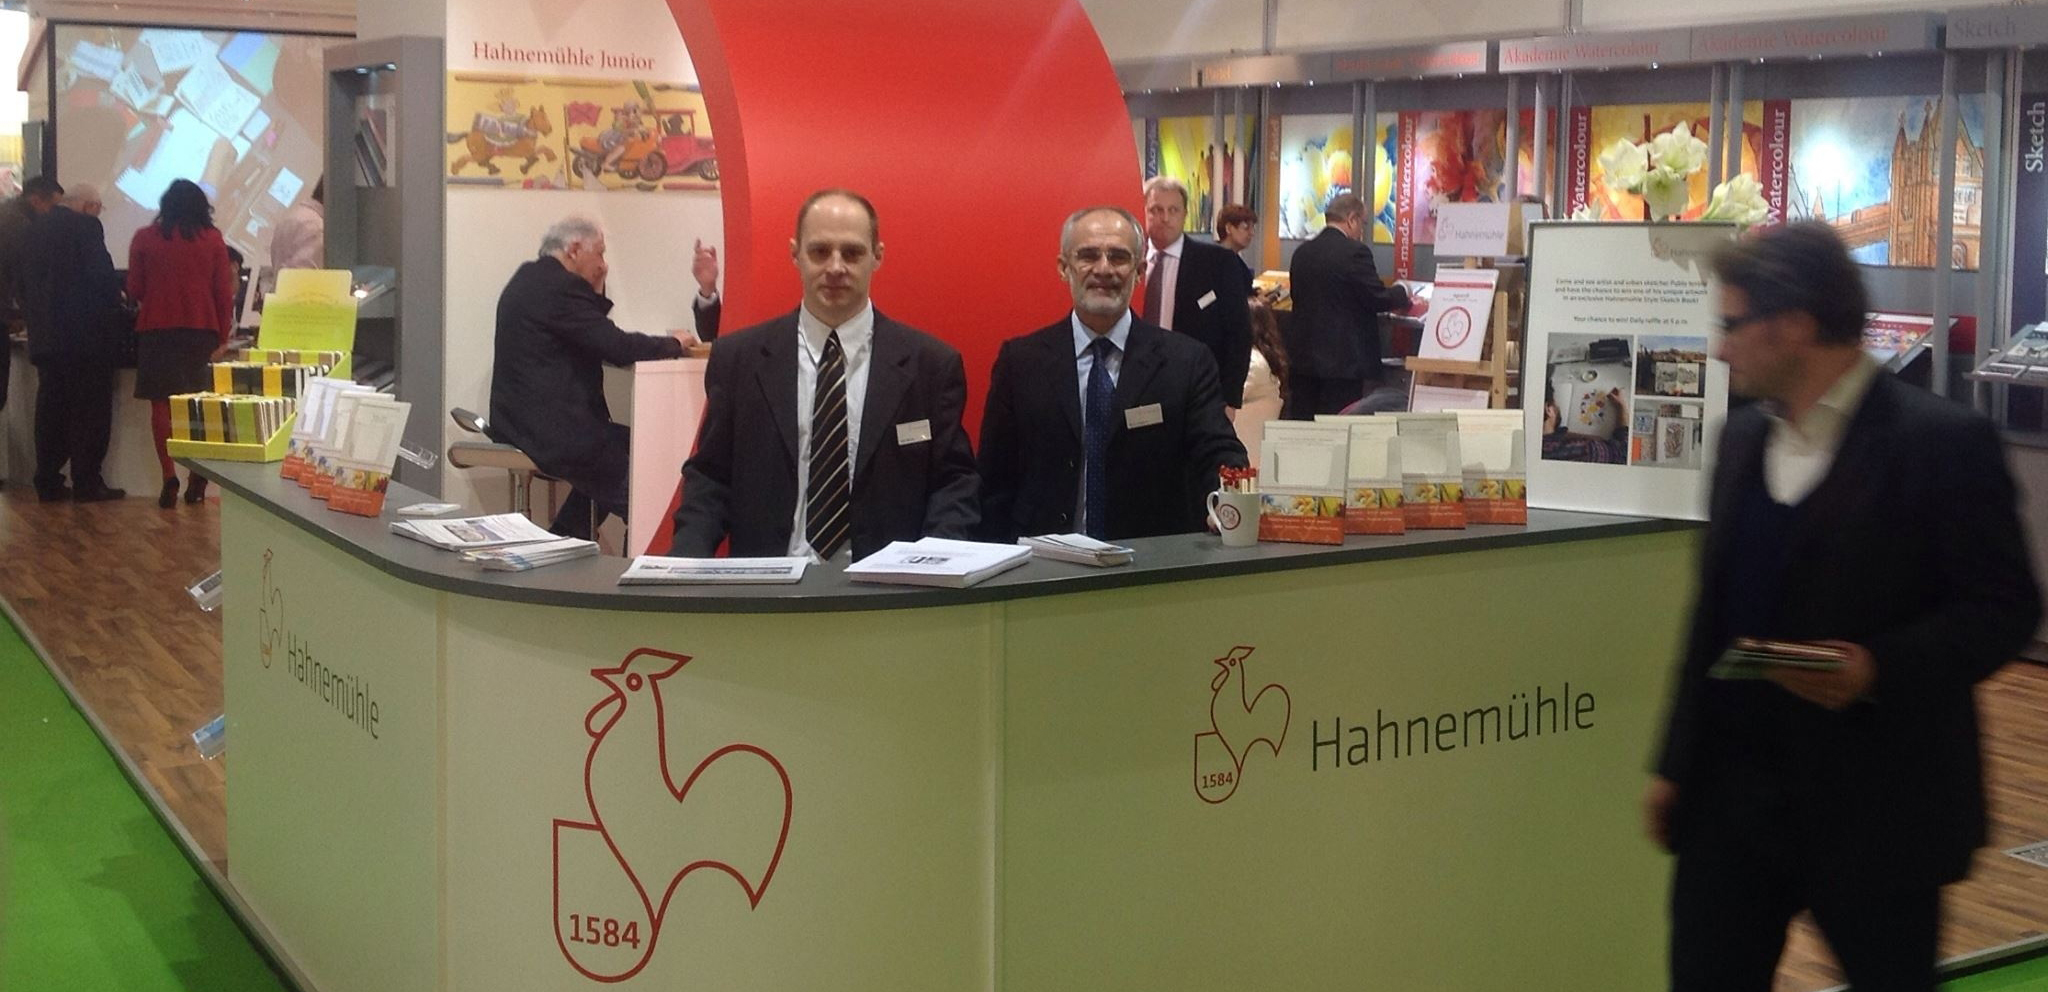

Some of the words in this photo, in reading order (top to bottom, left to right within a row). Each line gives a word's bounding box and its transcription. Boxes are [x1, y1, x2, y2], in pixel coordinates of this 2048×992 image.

[1784, 25, 1888, 46] Watercolour
[1954, 16, 2016, 38] Sketch
[473, 40, 594, 67] Hahnemühle
[600, 49, 656, 70] Junior
[1505, 45, 1568, 64] Akademie
[1575, 42, 1660, 58] Watercolour
[2025, 102, 2046, 172] Sketch
[1400, 118, 1414, 213] Watercolour
[1766, 109, 1785, 227] Watercolour
[287, 630, 379, 740] Hahnemühle
[1312, 682, 1595, 772] Hahnemühle
[1202, 771, 1233, 789] 1584
[569, 913, 641, 950] 1584
